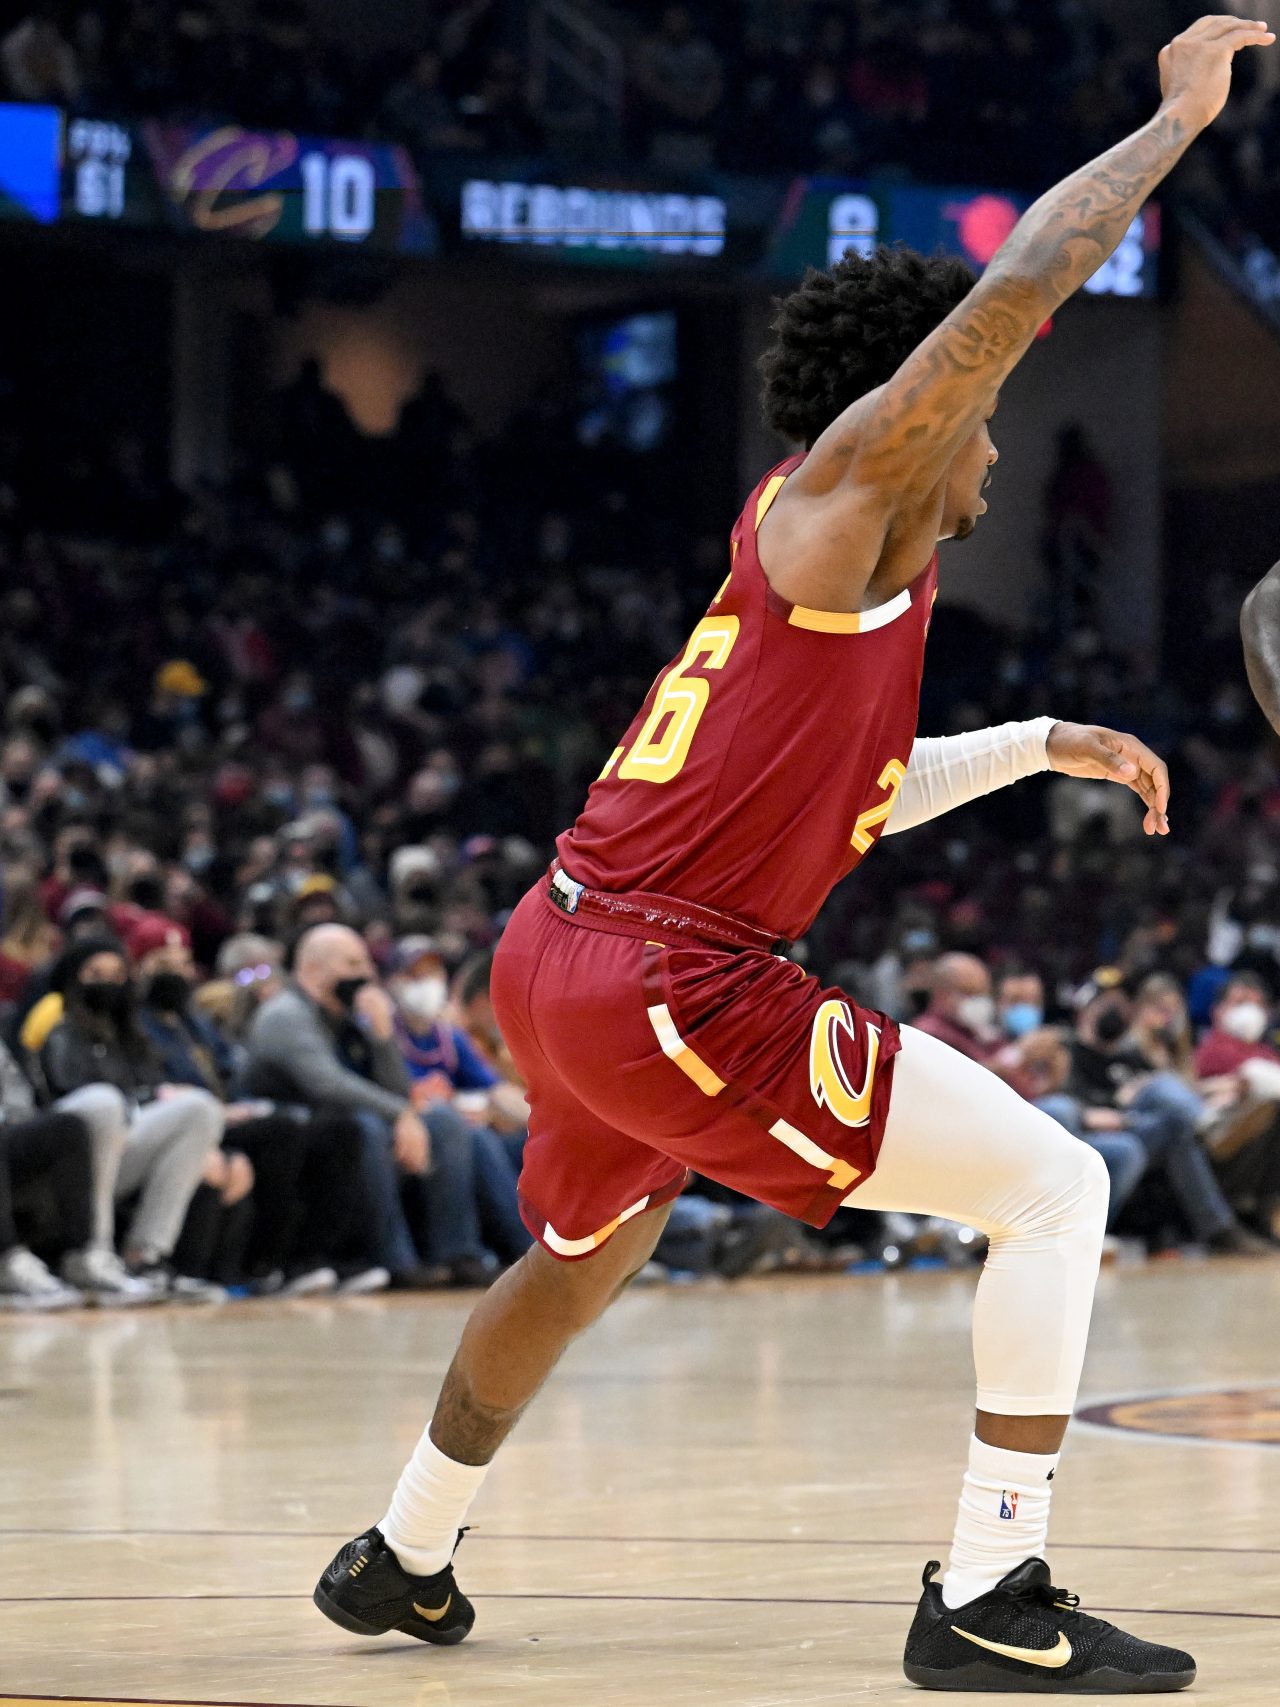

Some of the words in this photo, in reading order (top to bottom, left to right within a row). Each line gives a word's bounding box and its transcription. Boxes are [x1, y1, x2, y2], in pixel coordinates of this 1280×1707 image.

[302, 152, 375, 240] 10
[461, 180, 727, 257] REBOUNDS
[597, 614, 740, 784] 6
